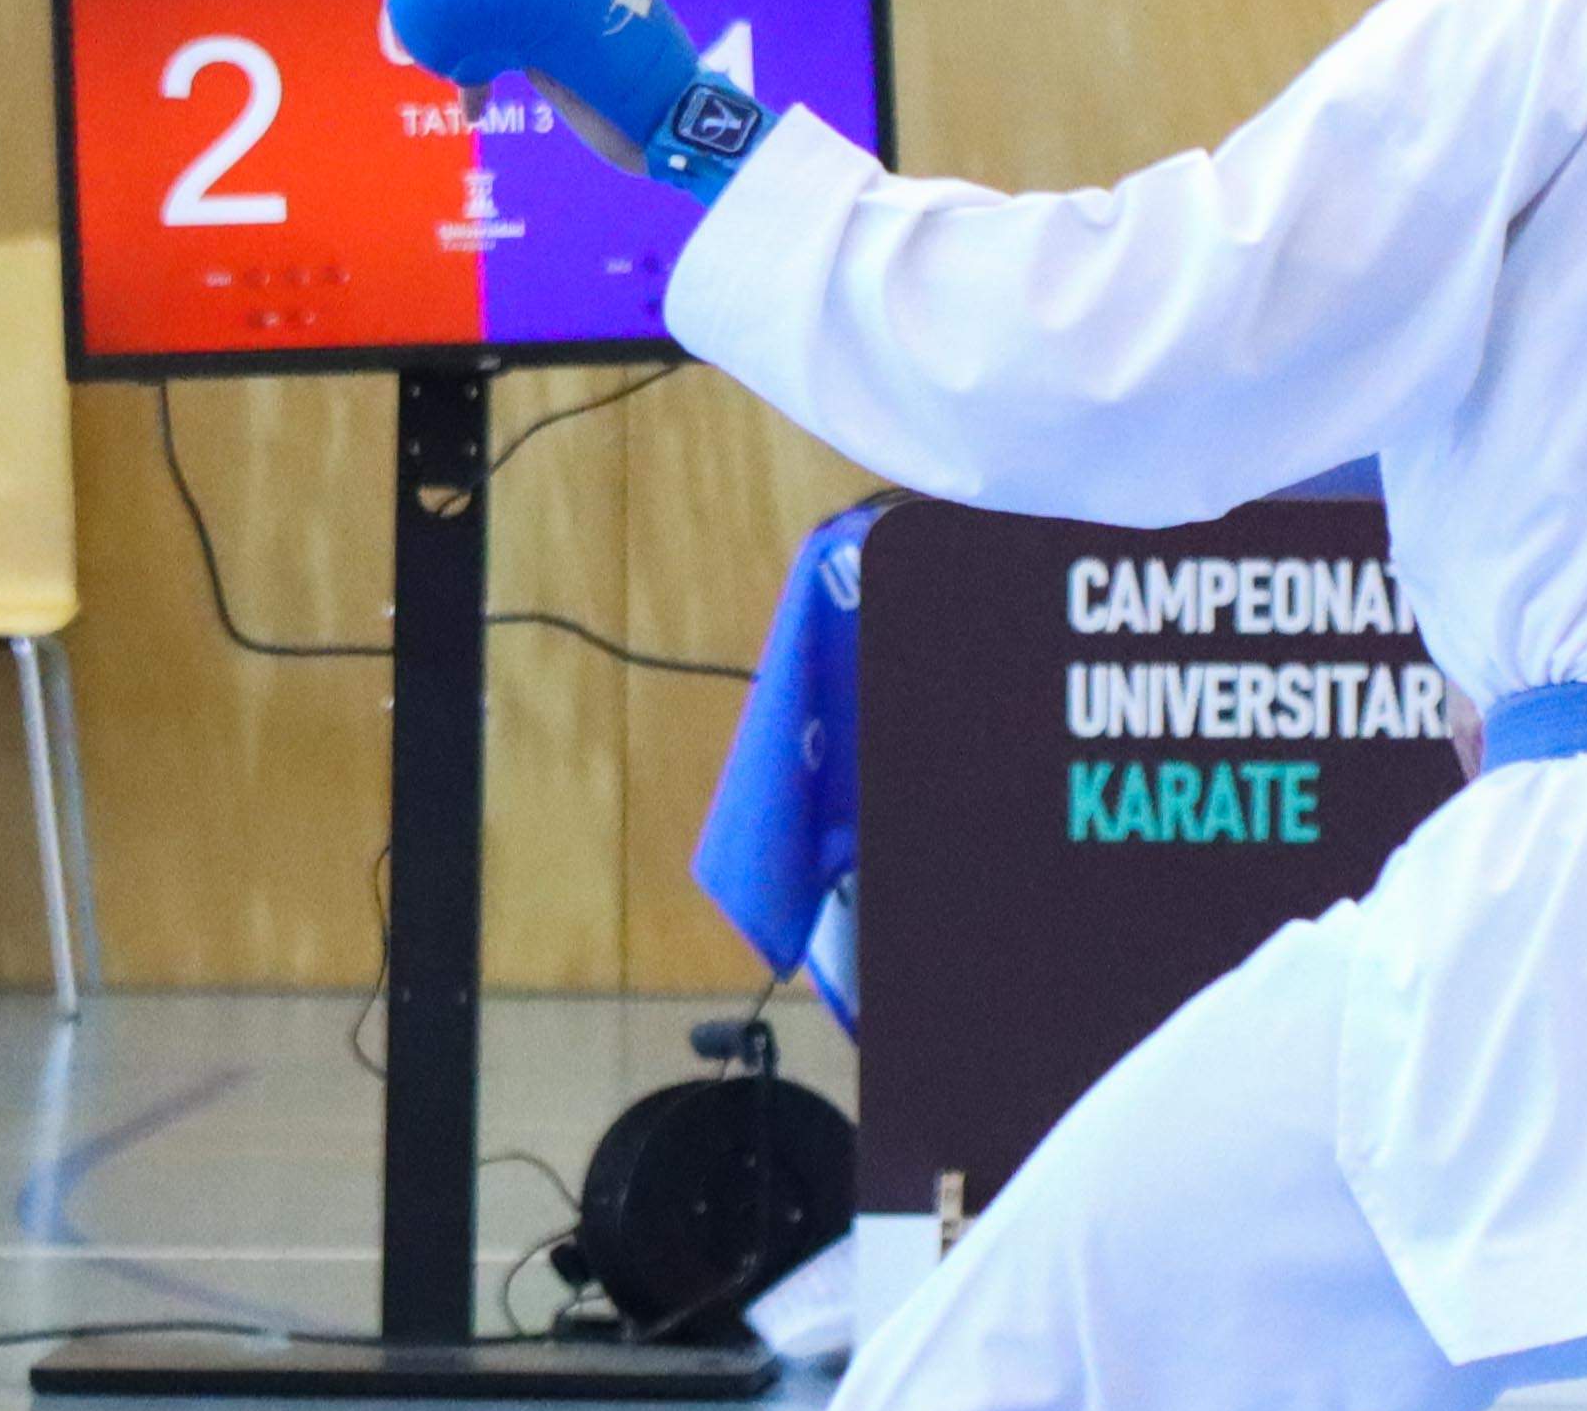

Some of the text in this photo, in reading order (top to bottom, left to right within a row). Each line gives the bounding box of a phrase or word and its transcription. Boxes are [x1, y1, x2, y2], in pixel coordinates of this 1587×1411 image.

[160, 33, 289, 228] 2
[533, 98, 555, 134] 3
[1066, 661, 1452, 740] UNIVERSITAR
[1067, 759, 1321, 843] KARATE
